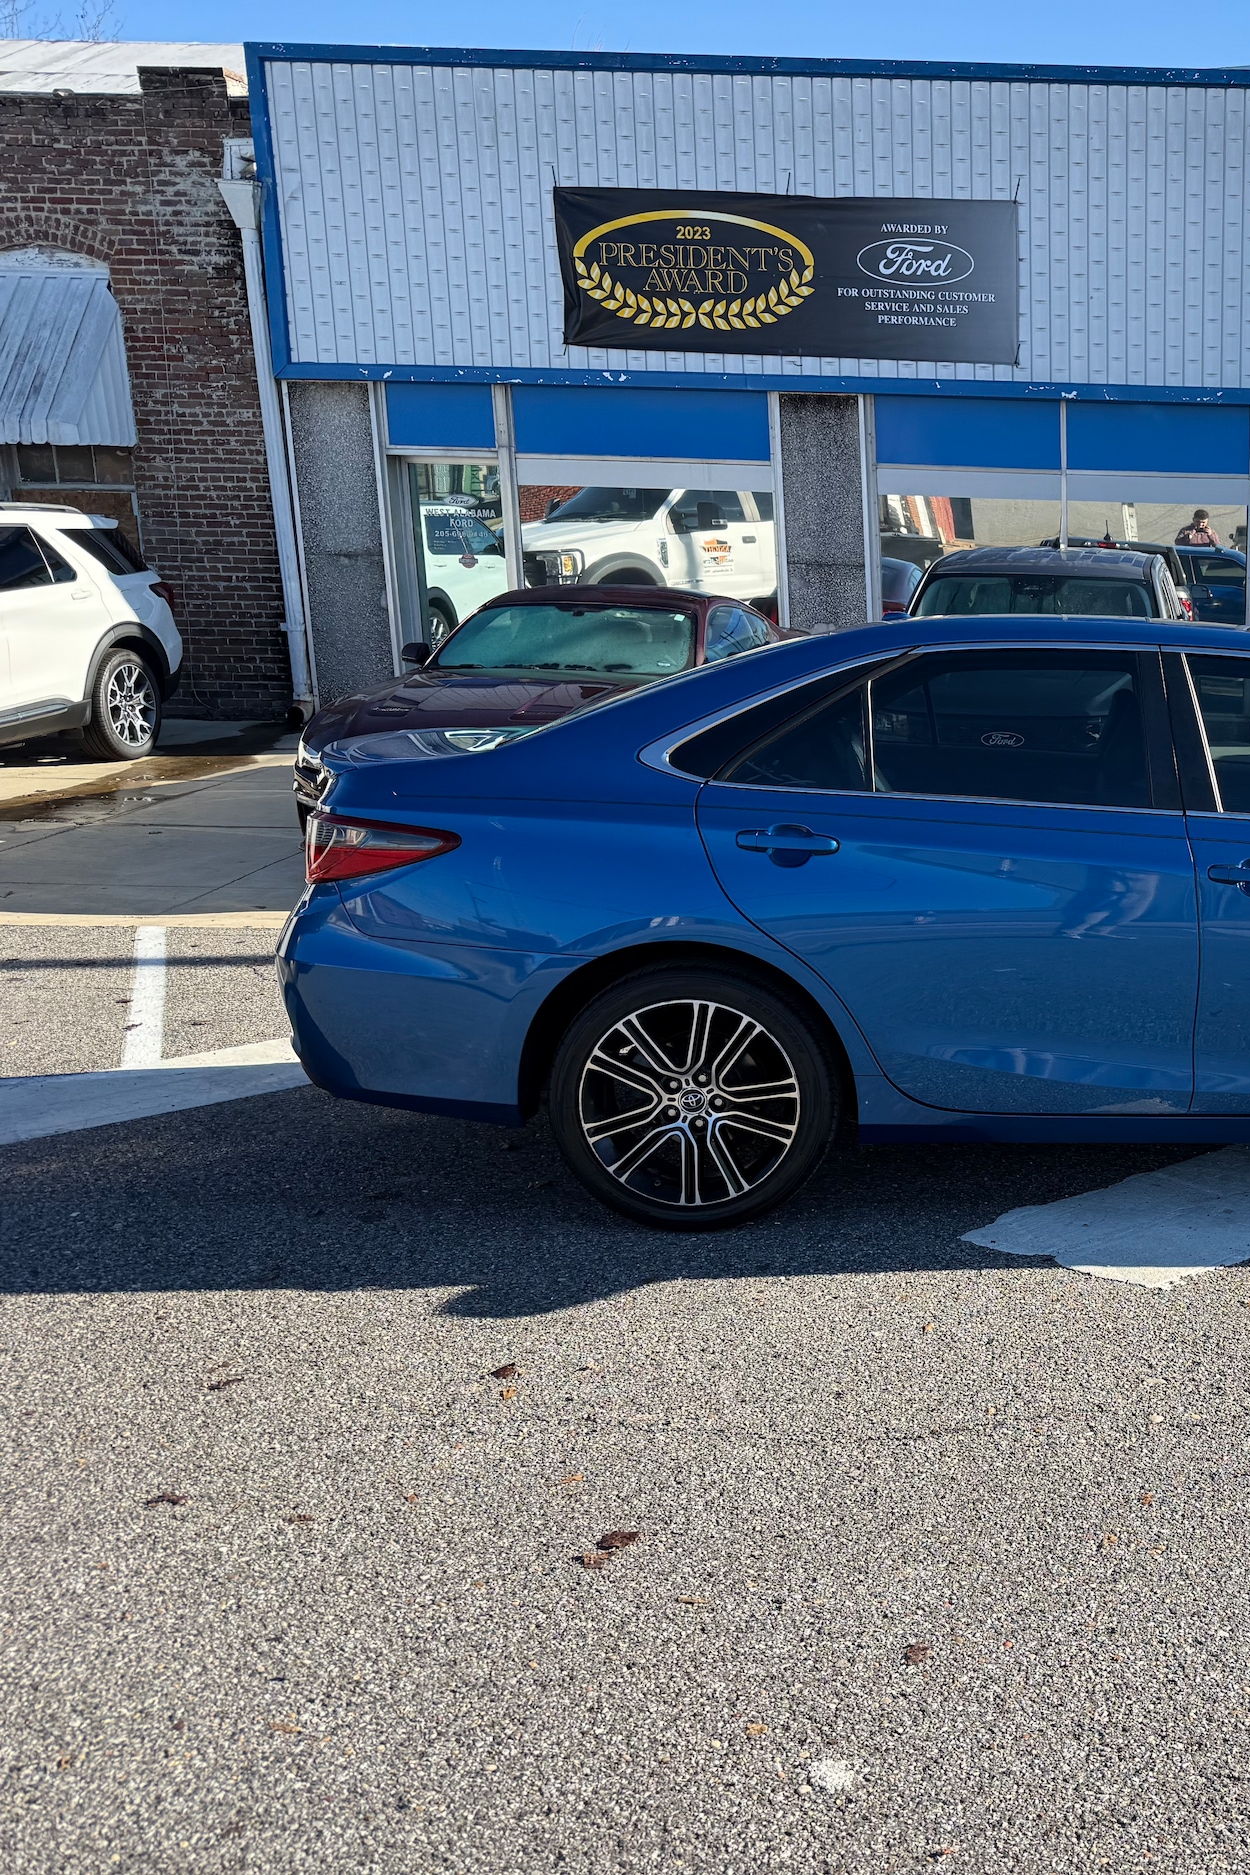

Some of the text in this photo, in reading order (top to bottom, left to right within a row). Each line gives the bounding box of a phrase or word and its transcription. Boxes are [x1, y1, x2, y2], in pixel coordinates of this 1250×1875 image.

[675, 225, 711, 241] 2023
[880, 223, 949, 235] AWARDED BY
[598, 242, 795, 272] PRESIDENT'S
[878, 243, 952, 277] Ford
[642, 267, 749, 295] AWARD
[837, 287, 996, 303] FOR OUTSTANDING CUSTOMER
[864, 301, 969, 314] SERVICE AND SALES
[877, 314, 957, 327] PERFORMANCE
[448, 495, 471, 505] Ford
[425, 508, 497, 518] WEST ALABAMA
[449, 517, 474, 528] FORD
[988, 733, 1017, 746] Ford
